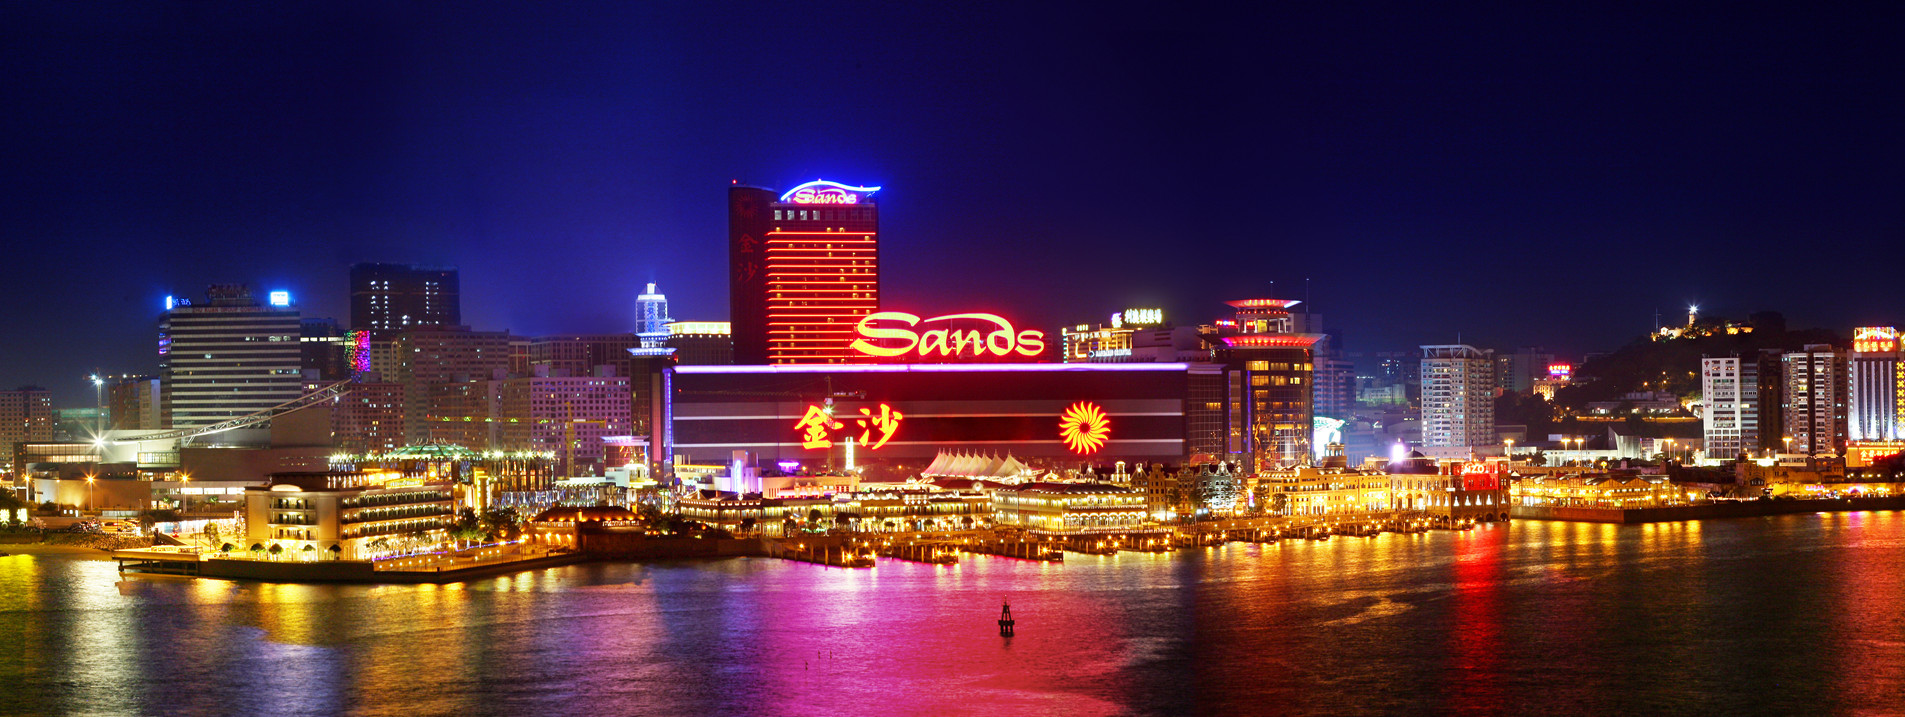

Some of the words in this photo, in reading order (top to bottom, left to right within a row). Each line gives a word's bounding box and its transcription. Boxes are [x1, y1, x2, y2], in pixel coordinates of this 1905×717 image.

[794, 188, 857, 204] Sands
[738, 233, 759, 283] 金沙
[850, 312, 1045, 357] Sands
[794, 404, 903, 450] 金沙
